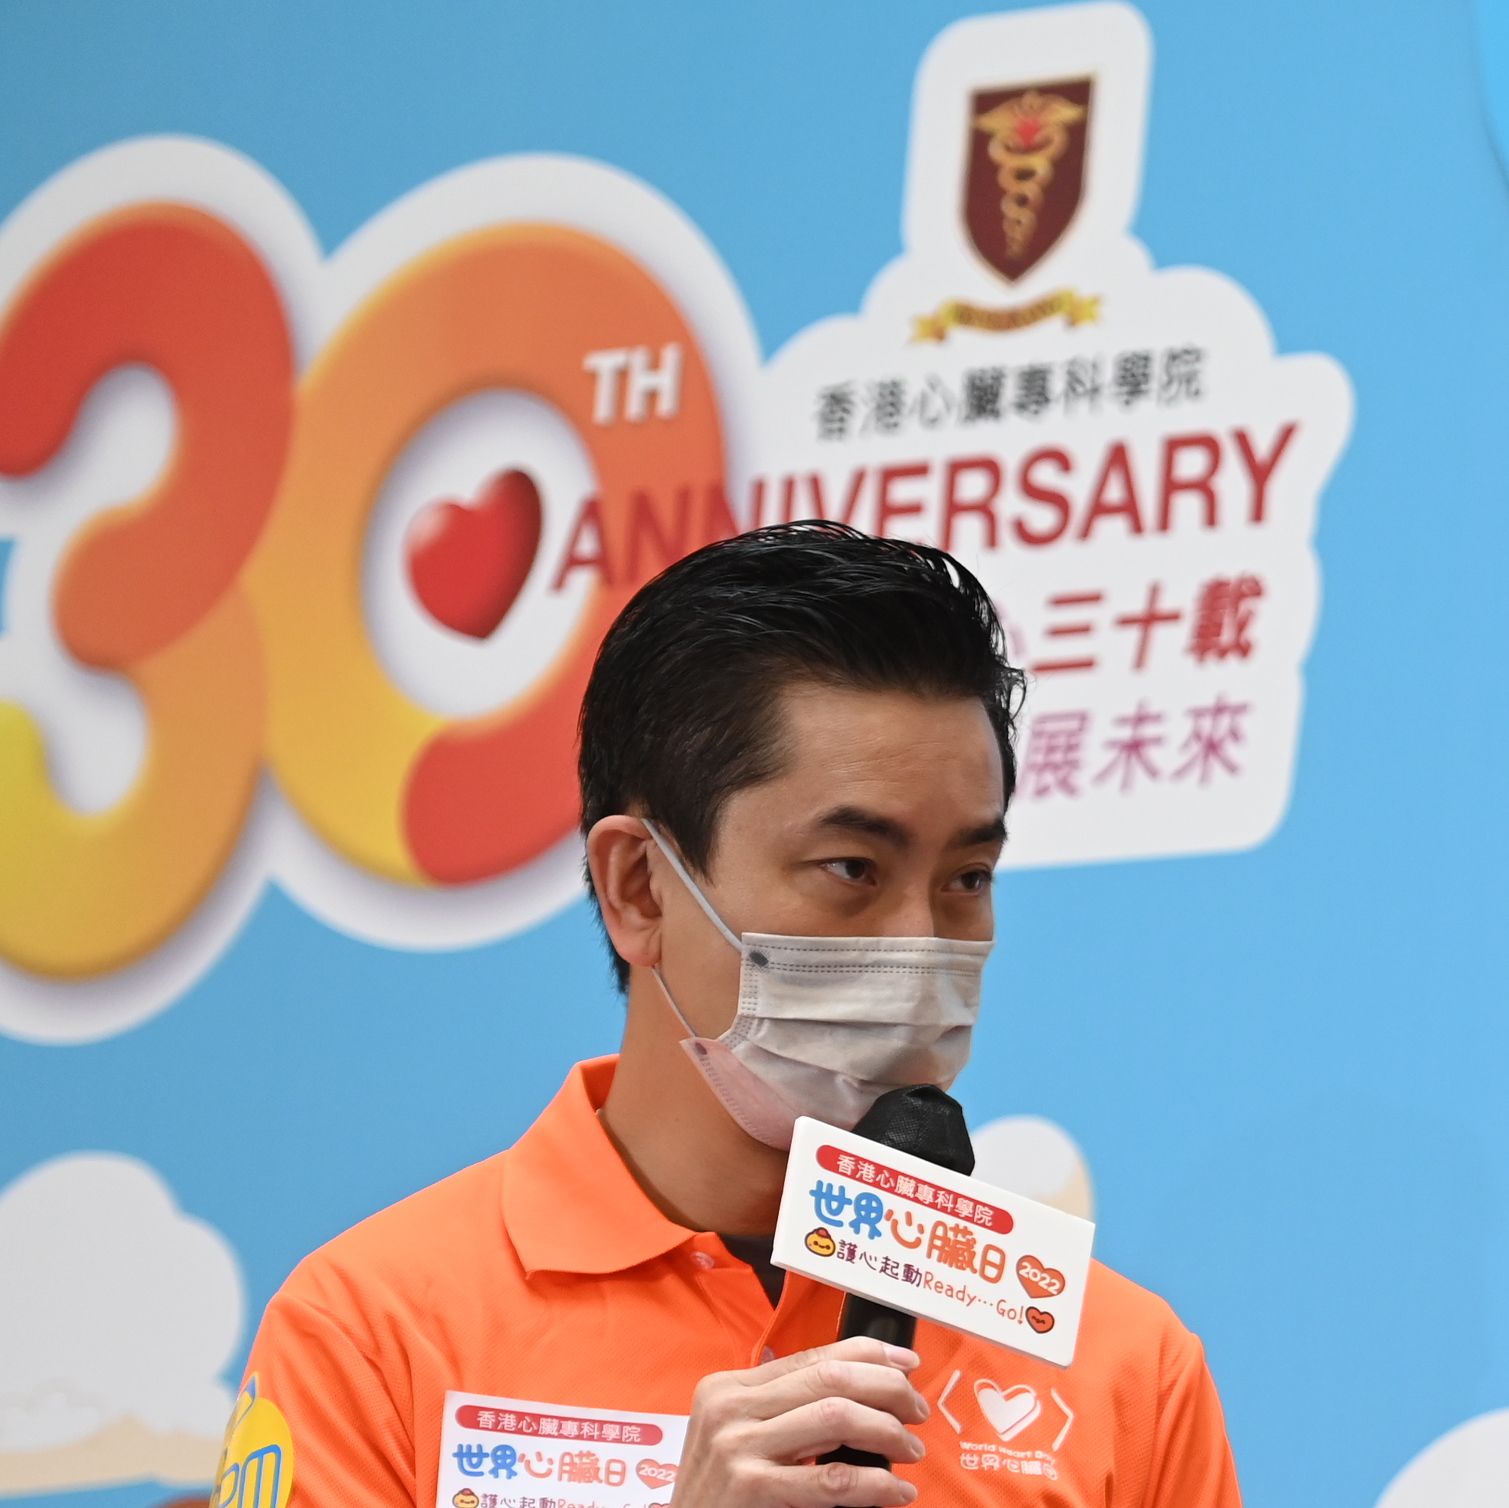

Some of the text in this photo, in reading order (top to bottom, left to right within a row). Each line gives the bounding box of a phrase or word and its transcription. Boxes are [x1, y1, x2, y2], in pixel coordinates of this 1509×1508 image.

[583, 342, 683, 426] TH
[816, 344, 1208, 442] 香港心臟專科學院
[1000, 573, 1267, 674] 三十載
[836, 1153, 994, 1227] 香港心臟專科學院
[809, 1180, 1007, 1284] 世界心臟日
[836, 1239, 923, 1288] 護心起動
[1018, 1261, 1062, 1295] 2022
[477, 1410, 641, 1443] 香港心臟專科學院
[959, 1441, 996, 1452] World
[452, 1443, 627, 1487] 世界心臟日
[640, 1464, 676, 1482] 2022
